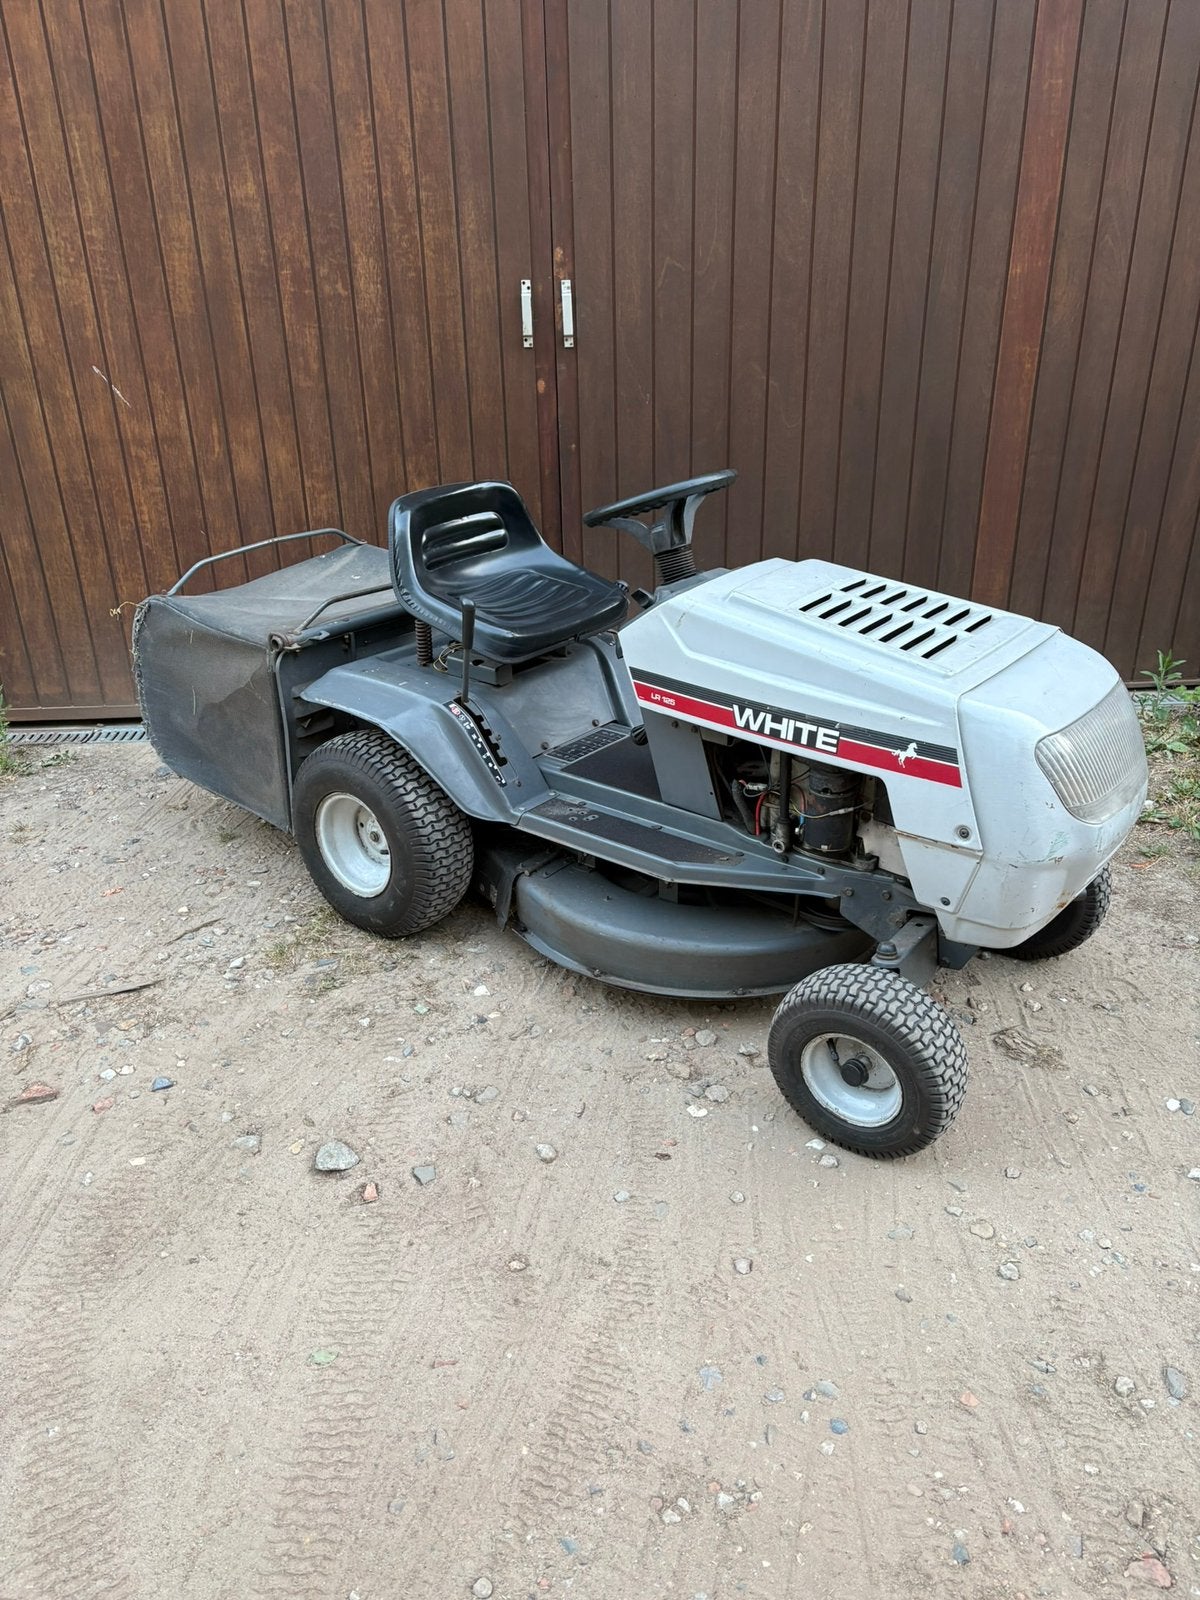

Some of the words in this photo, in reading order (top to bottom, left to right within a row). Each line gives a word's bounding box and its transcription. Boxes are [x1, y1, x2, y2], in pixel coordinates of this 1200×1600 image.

[651, 692, 661, 701] LR
[662, 696, 676, 706] 125
[732, 704, 840, 753] WHITE
